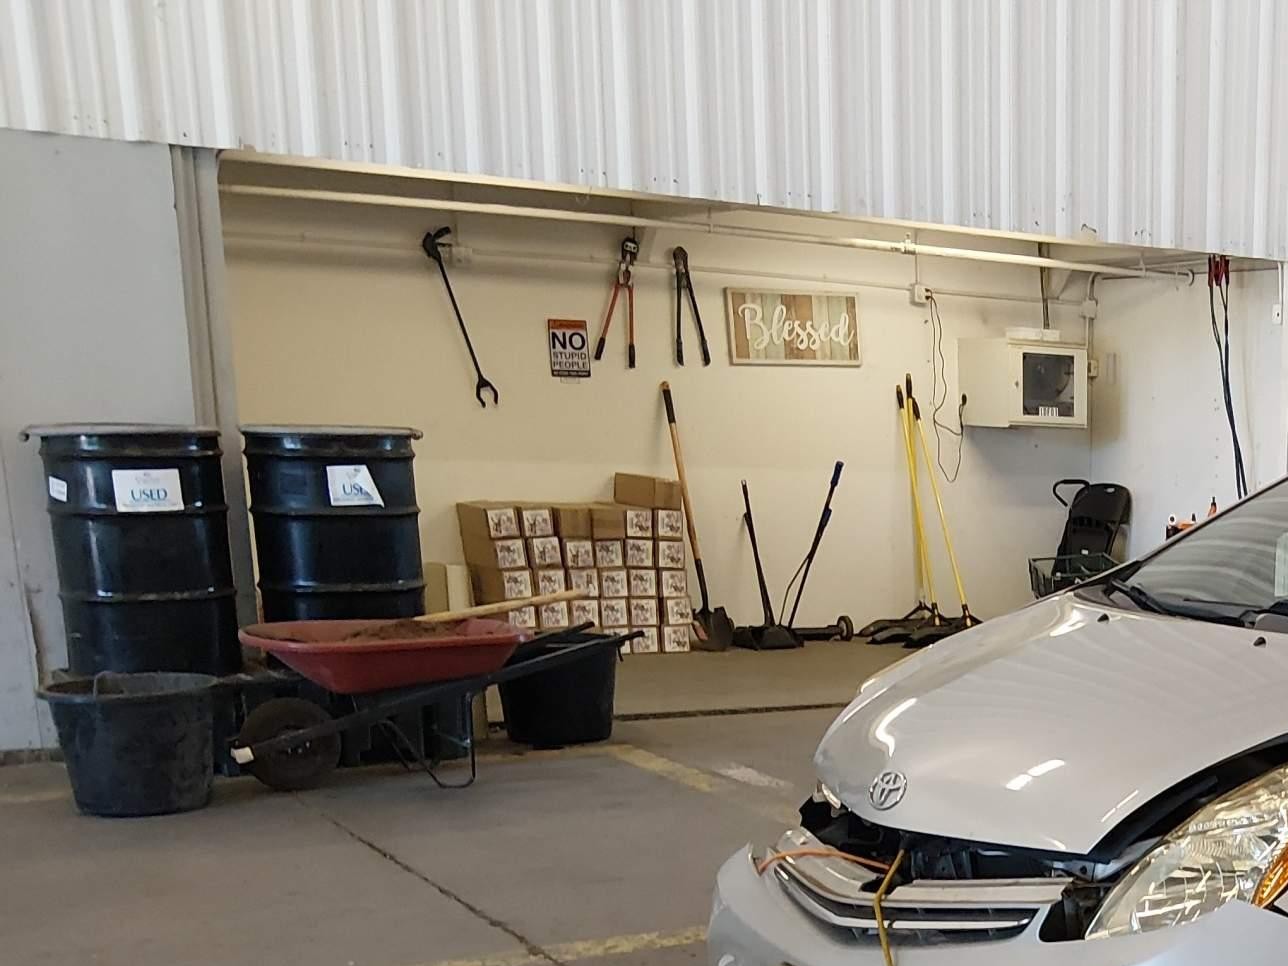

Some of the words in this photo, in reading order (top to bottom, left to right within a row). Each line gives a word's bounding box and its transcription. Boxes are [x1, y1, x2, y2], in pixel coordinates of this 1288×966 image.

[738, 304, 855, 351] Blessed
[551, 331, 586, 350] NO
[553, 351, 587, 361] STUPID
[553, 360, 588, 369] PEOPLE
[130, 488, 168, 501] USED
